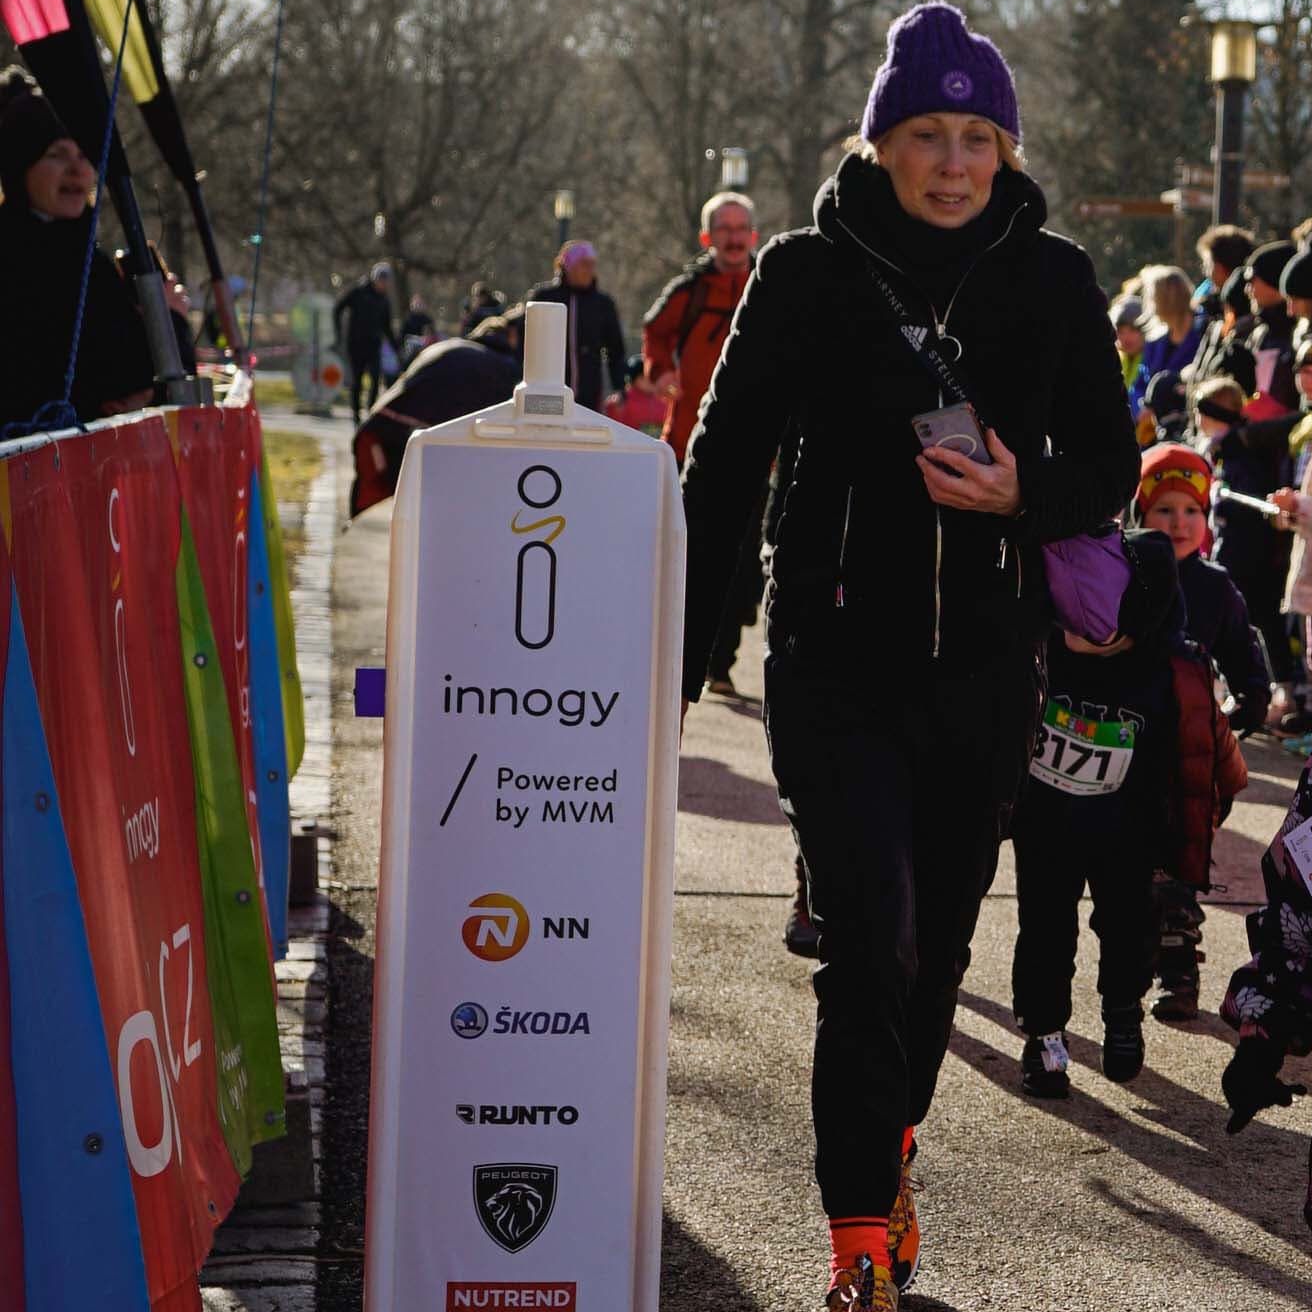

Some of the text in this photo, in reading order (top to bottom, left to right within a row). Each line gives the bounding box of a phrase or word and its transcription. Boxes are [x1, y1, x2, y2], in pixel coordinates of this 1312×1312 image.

[444, 674, 620, 728] innogy
[496, 768, 618, 793] Powered
[496, 798, 614, 828] by MVM
[542, 917, 589, 939] NN
[492, 1006, 591, 1035] ŠKODA
[479, 1105, 579, 1126] RUNTO
[481, 1171, 549, 1181] PEUGEOT
[454, 1289, 571, 1308] NUTREND
